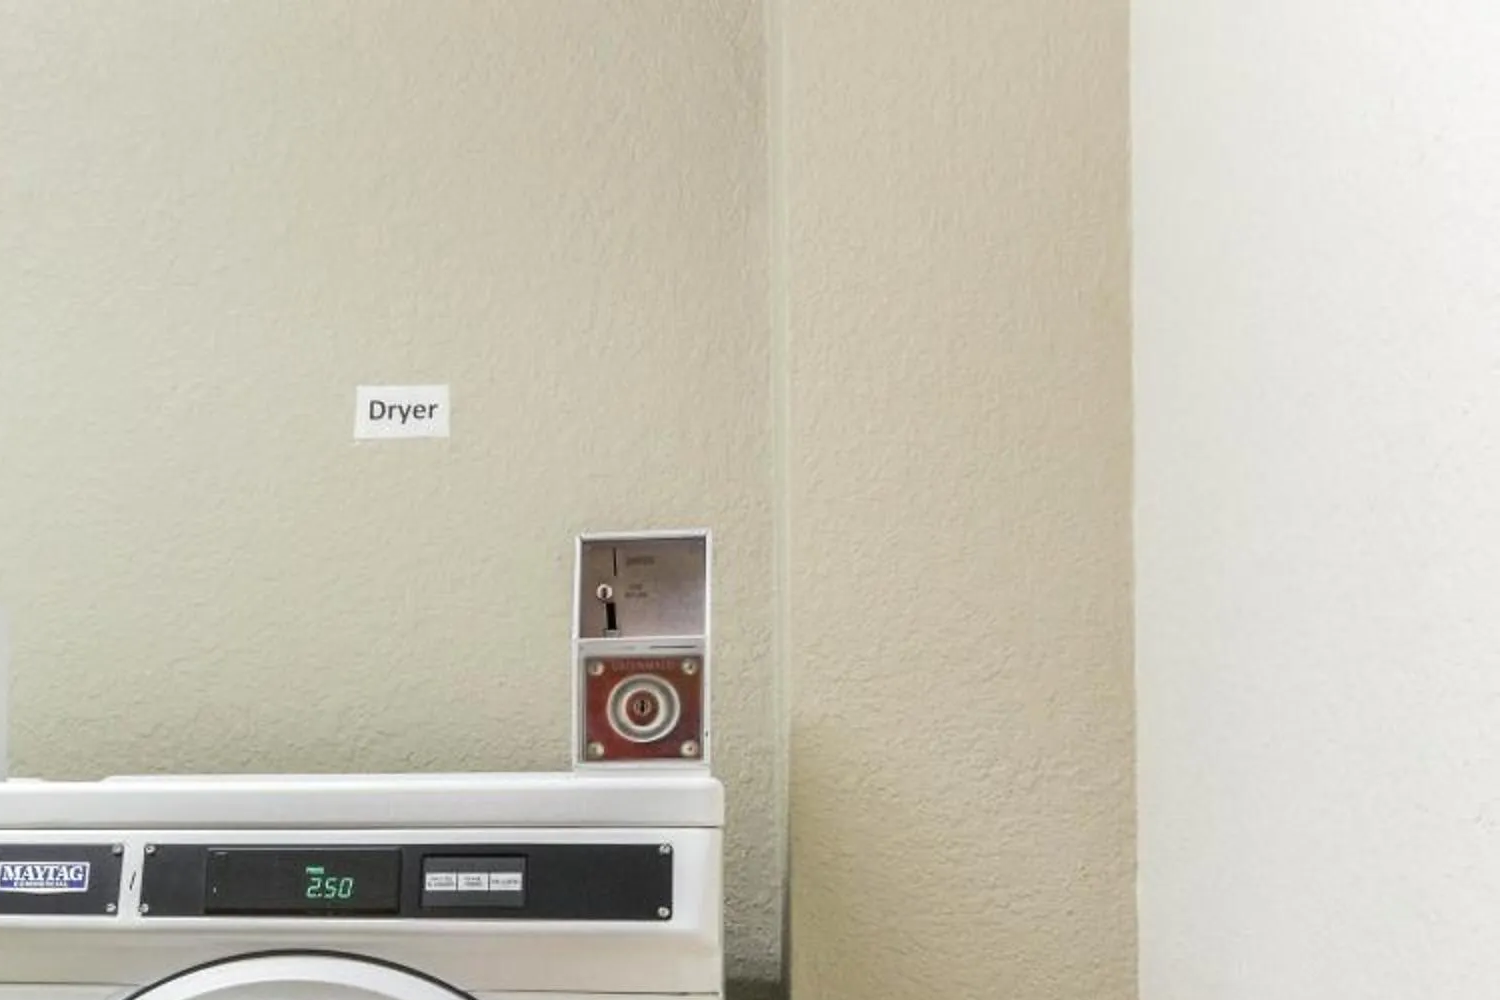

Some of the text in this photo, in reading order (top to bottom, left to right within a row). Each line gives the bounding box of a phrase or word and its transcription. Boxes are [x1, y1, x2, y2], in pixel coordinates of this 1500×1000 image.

[368, 399, 439, 425] Dryer
[1, 865, 85, 881] MAYTAG
[306, 877, 354, 899] 2.50
